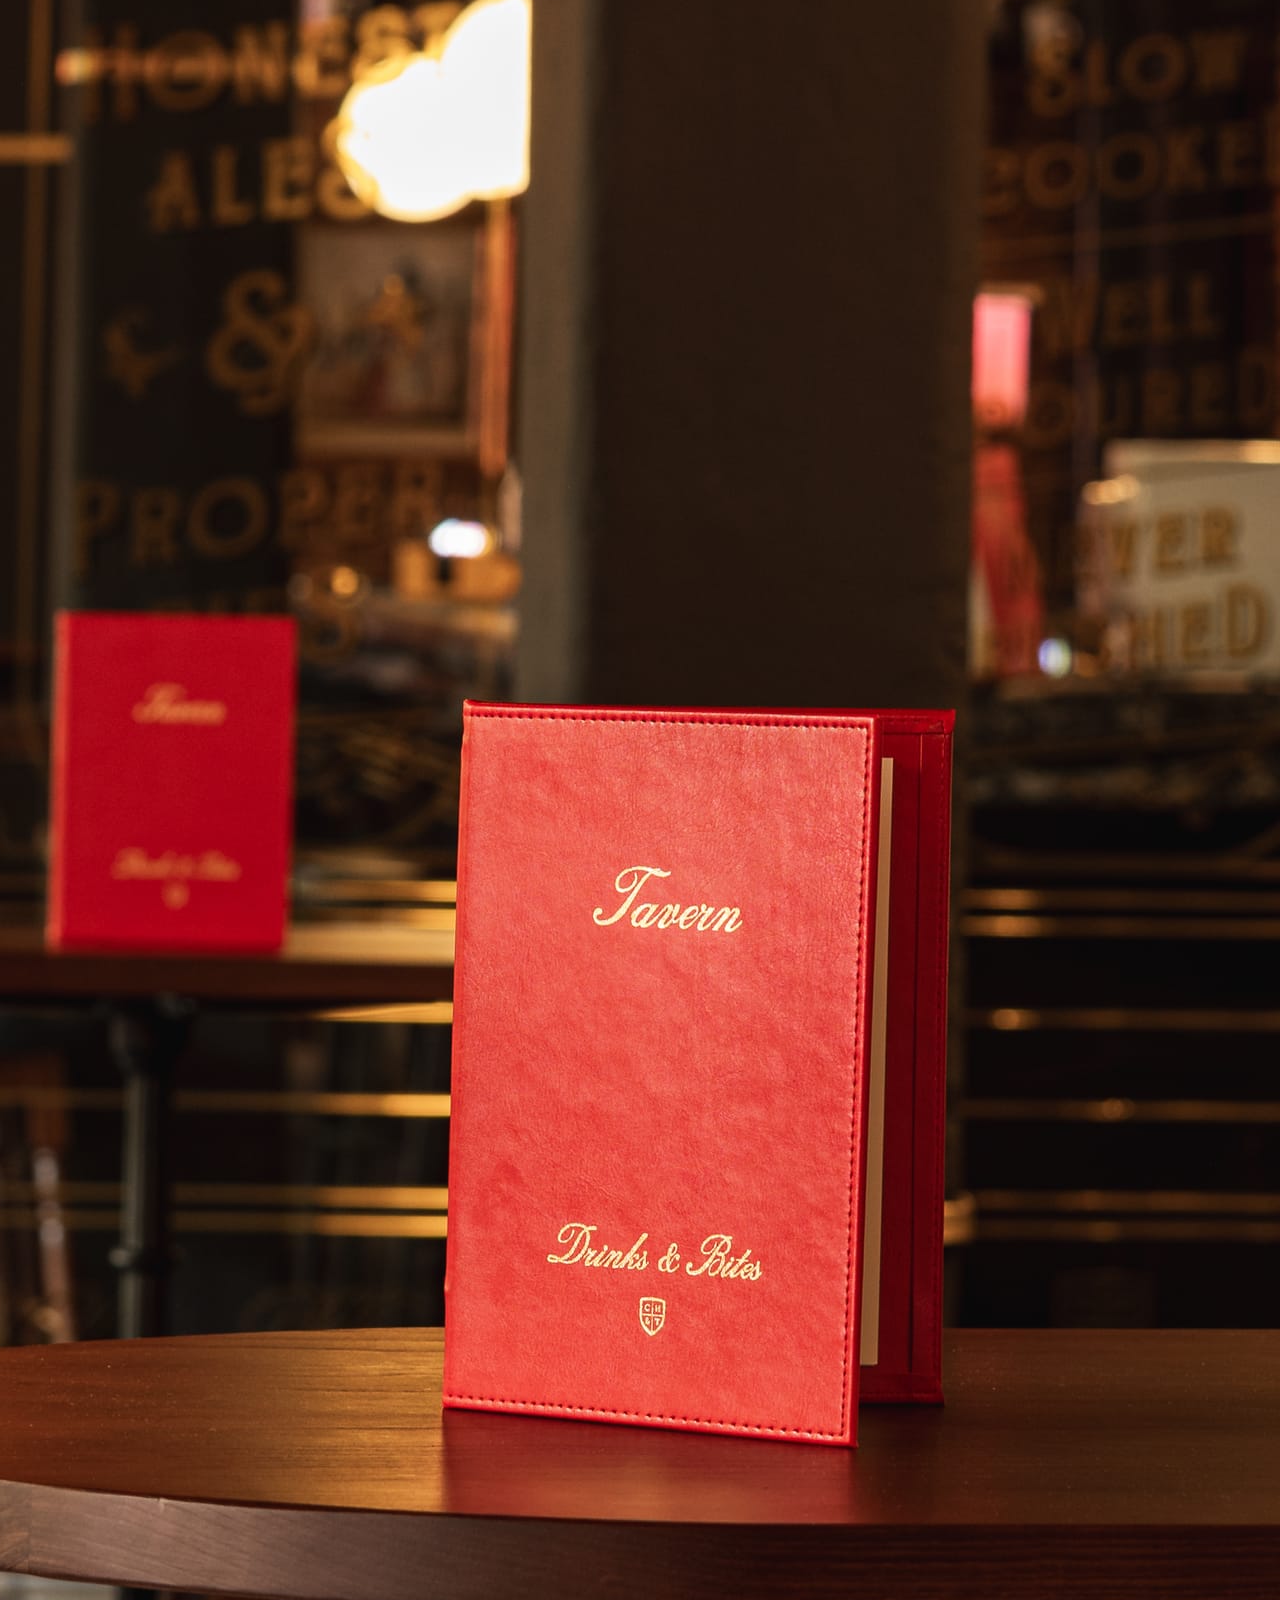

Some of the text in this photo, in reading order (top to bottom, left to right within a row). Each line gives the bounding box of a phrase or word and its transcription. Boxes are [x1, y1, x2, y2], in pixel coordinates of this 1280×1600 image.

[206, 268, 316, 416] &
[592, 864, 744, 934] Tavern
[546, 1221, 763, 1282] Drinks & Bites
